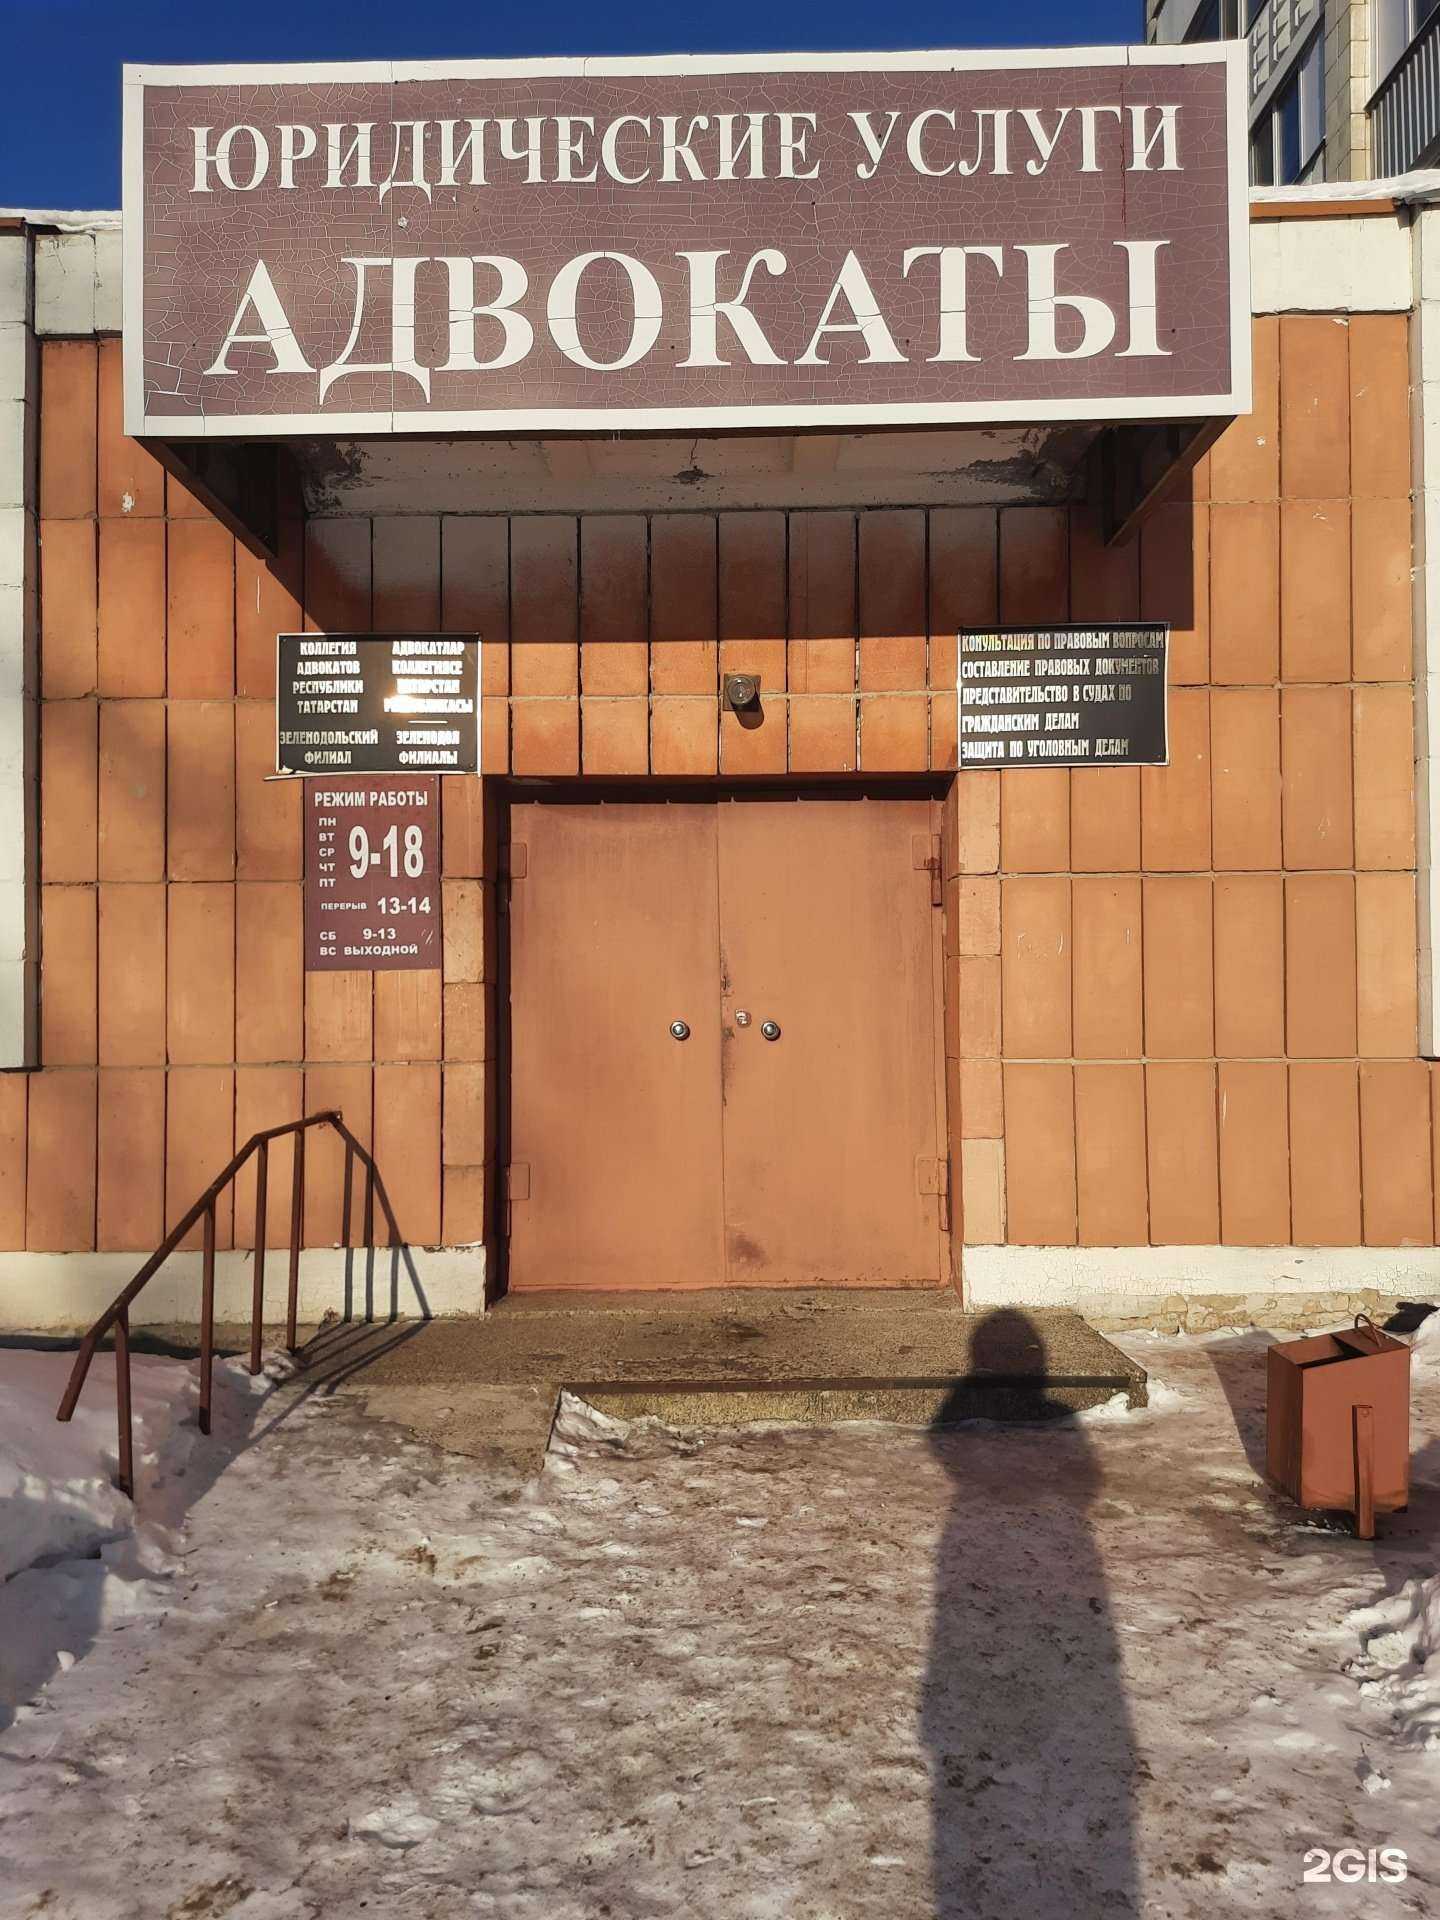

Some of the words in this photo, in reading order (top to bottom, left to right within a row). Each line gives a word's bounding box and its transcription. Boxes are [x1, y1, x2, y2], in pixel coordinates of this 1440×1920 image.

[188, 111, 822, 205] ЮРИДИЧЕСКИЕ
[847, 105, 1184, 180] УСЛУГИ
[203, 240, 1173, 405] АДВОКАТЫ
[1037, 633, 1051, 650] ПО
[1054, 632, 1109, 650] ПРАВОВЫМ
[1113, 631, 1164, 649] ВОПРОСАМ
[300, 641, 356, 656] КОЛЛЕГИЯ
[392, 641, 465, 656] АДВОКАТЛАР
[297, 661, 360, 676] АДВОКАТОВ
[962, 659, 1031, 678] СОСТАВЛЕНИЕ
[1035, 658, 1090, 676] ПРАВОВЫХ
[1094, 656, 1159, 676] ДОКУМЕНТОВ
[292, 679, 364, 695] РЕСПУБЛИКИ
[962, 684, 1068, 706] ПРЕДСТАВИТЕЛЬСТВО
[1073, 685, 1080, 702] В
[1083, 684, 1115, 703] СУДАХ
[1118, 684, 1132, 701] ПО
[297, 699, 359, 714] ТАТАРСТАН
[962, 713, 1040, 733] ГРАЖДАНСКИМ
[1044, 712, 1080, 731] ДЕЛАМ
[280, 729, 378, 745] ЗЕЛЕНОДОЛЬСКИЙ
[962, 740, 1005, 760] ЗАЩИТА
[1009, 740, 1023, 758] ПО
[1027, 739, 1090, 757] УГОЛОВНЫМ
[1094, 738, 1129, 757] ДЕЛАМ
[304, 750, 352, 765] ФИЛИАЛ
[399, 750, 458, 765] ФИЛИАЛЫ
[314, 791, 366, 807] РЕЖИМ
[369, 791, 428, 806] РАБОТЫ
[318, 817, 337, 827] ПН
[318, 832, 335, 842] ВТ
[318, 848, 336, 857] СР
[349, 825, 424, 879] 9-18
[318, 863, 336, 872] ЧТ
[319, 878, 336, 887] ПТ
[320, 902, 368, 911] ПЕРЕРЫВ
[377, 896, 432, 914] 13-14
[319, 931, 337, 941] СБ
[362, 927, 396, 941] 9-13
[319, 946, 337, 956] ВС
[343, 944, 418, 957] ВЫХОДНОЙ
